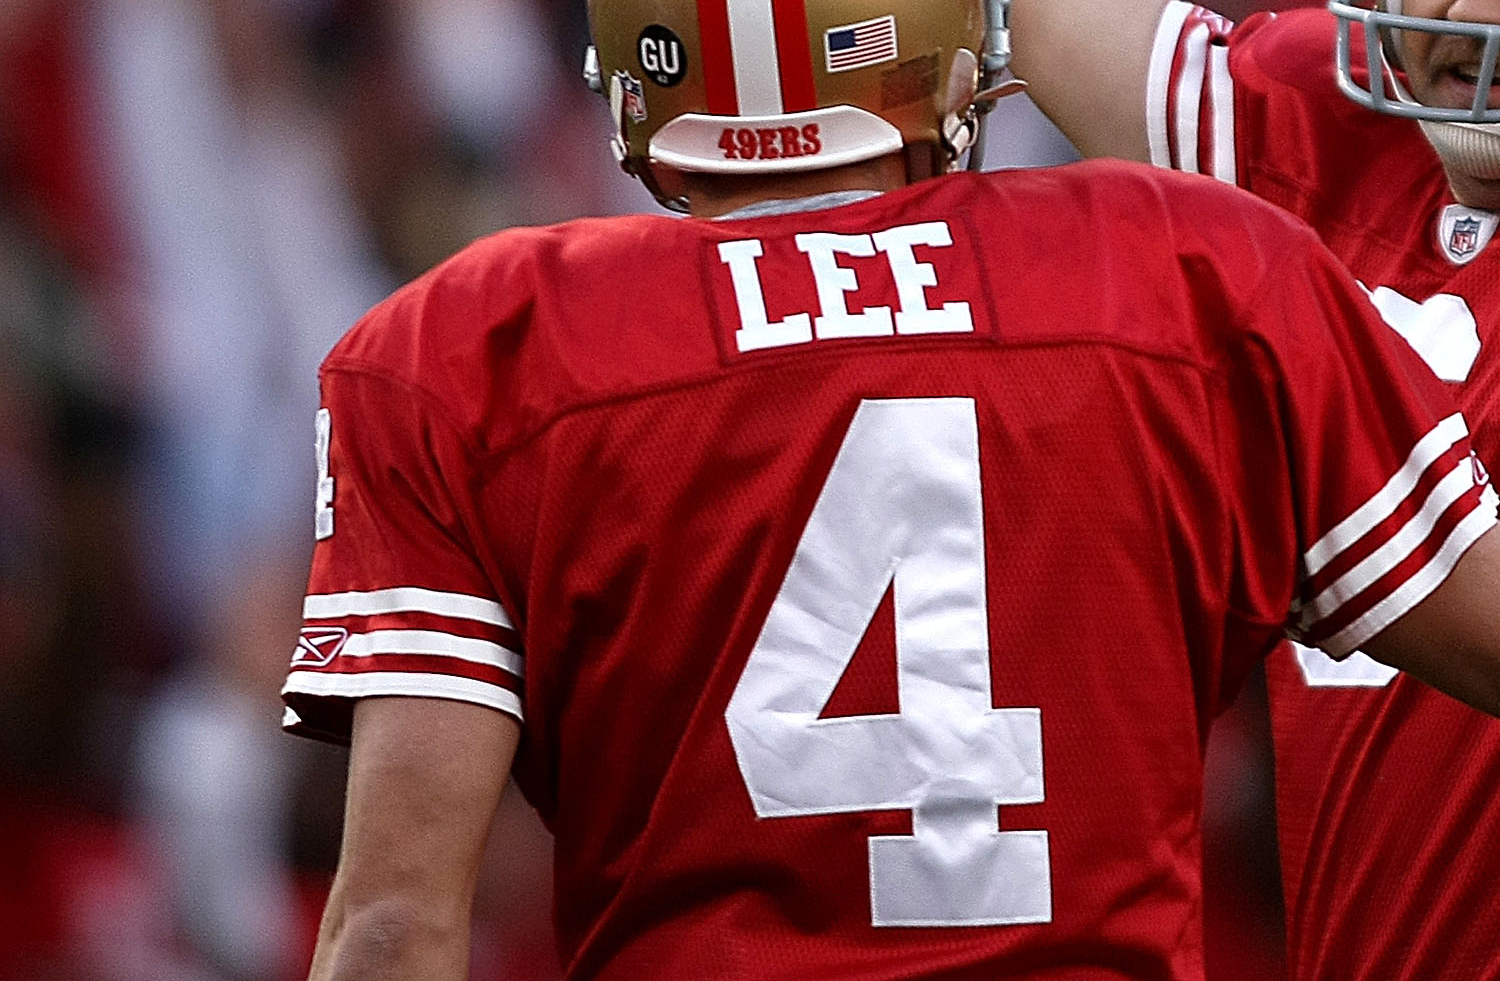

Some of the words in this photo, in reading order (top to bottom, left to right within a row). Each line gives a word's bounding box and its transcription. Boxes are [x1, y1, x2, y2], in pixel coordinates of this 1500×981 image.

[640, 37, 680, 75] GU
[718, 122, 822, 159] 49ERS
[718, 222, 974, 352] LEE
[725, 397, 1053, 928] 4
